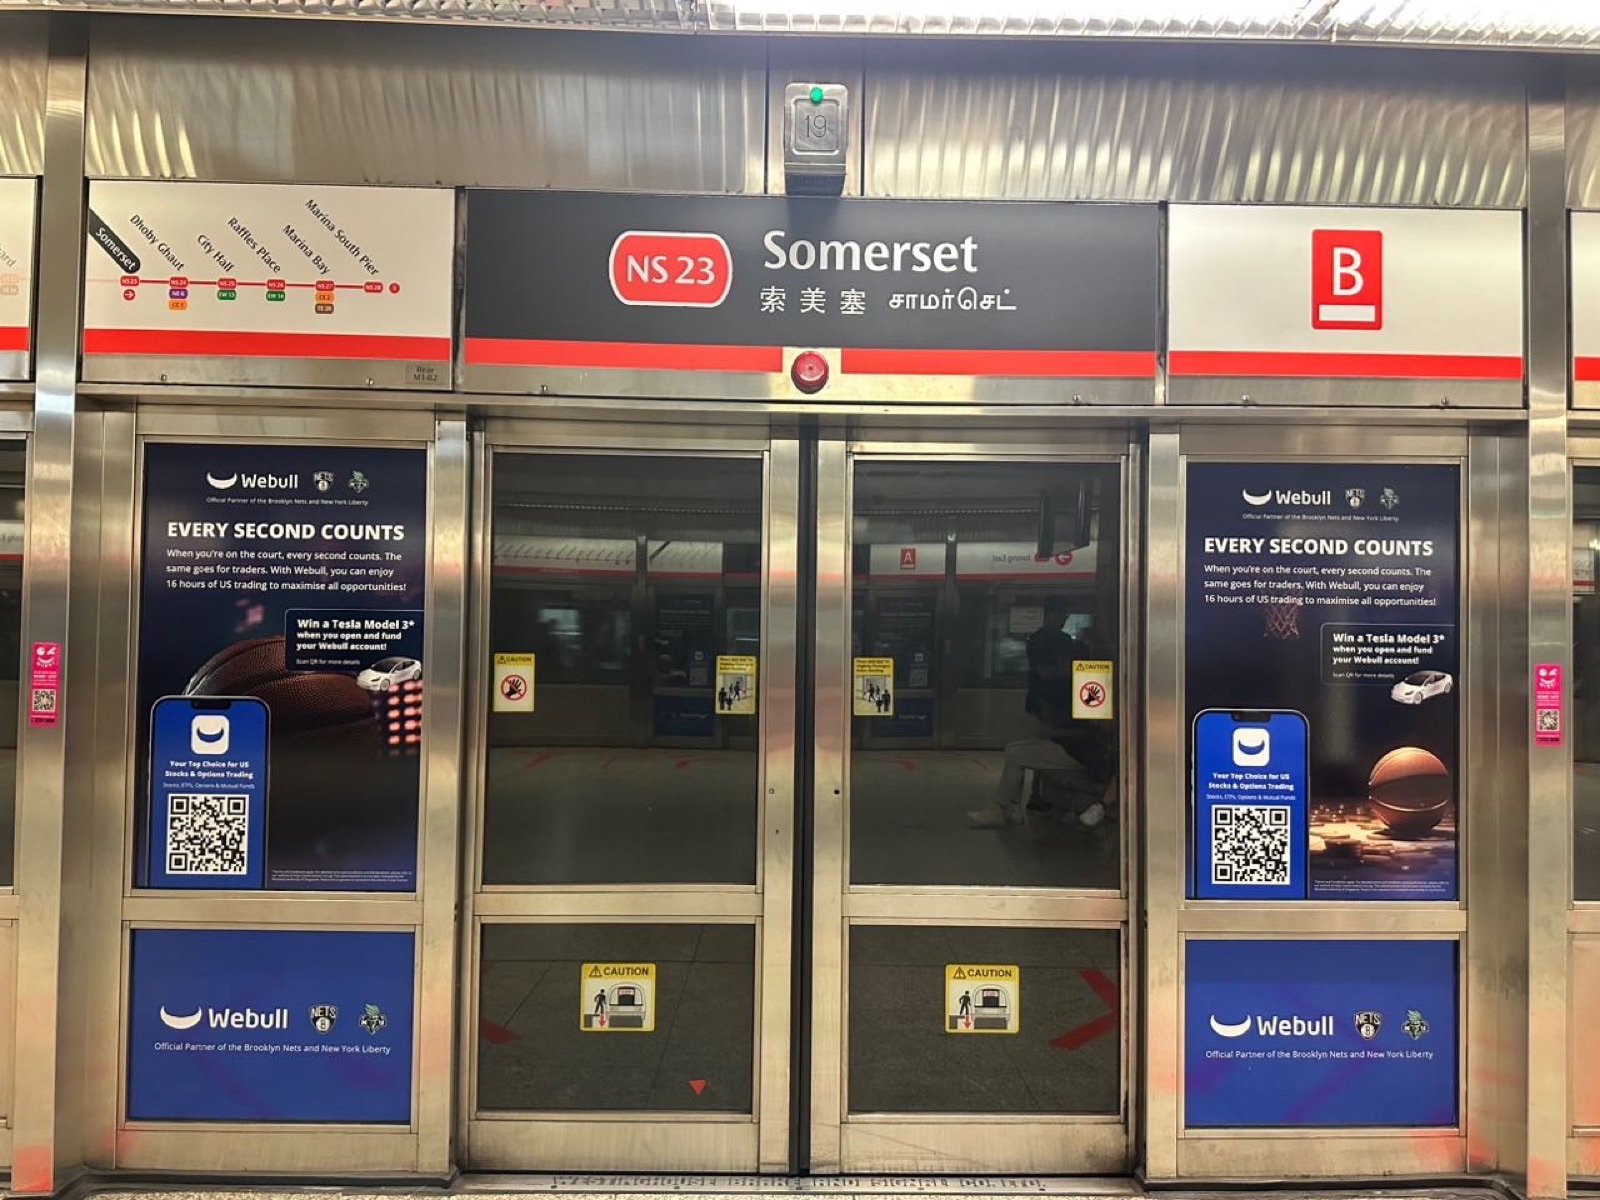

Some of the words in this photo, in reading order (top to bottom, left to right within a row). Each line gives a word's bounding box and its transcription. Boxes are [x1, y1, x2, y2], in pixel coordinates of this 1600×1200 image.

[805, 115, 827, 138] 19
[130, 214, 158, 245] Dhoby
[158, 243, 185, 271] Ghaut
[228, 217, 258, 250] Raffles
[256, 247, 281, 273] Place
[305, 199, 336, 231] Marina
[335, 229, 360, 258] South
[359, 255, 379, 275] Pier
[96, 227, 136, 270] Somerset
[197, 234, 214, 255] City
[213, 252, 235, 272] Hall
[282, 225, 312, 258] Marina
[312, 255, 330, 275] Bay
[763, 230, 978, 273] Somerset
[626, 256, 668, 284] NS
[675, 257, 715, 285] 23
[1332, 246, 1364, 296] B
[760, 286, 866, 315] 索美塞
[241, 473, 298, 489] Webull
[1275, 490, 1331, 505] Webull
[167, 522, 229, 537] EVERY
[234, 522, 315, 539] SECOND
[320, 524, 405, 540] COUNTS
[1204, 537, 1265, 553] EVERY
[1269, 538, 1348, 554] SECOND
[1354, 540, 1433, 556] COUNTS
[166, 550, 194, 558] When
[195, 550, 224, 561] you're
[240, 550, 255, 558] the
[257, 551, 284, 560] court,
[287, 552, 312, 561] every
[314, 551, 346, 560] second
[348, 552, 382, 561] counts.
[385, 552, 402, 561] The
[193, 565, 214, 575] goes
[216, 564, 230, 573] for
[232, 565, 268, 574] traders.
[270, 565, 292, 574] With
[294, 565, 328, 576] Webull,
[330, 567, 348, 577] you
[368, 567, 394, 578] enjoy
[1204, 564, 1230, 573] When
[1233, 565, 1260, 576] you're
[1276, 565, 1291, 574] the
[1293, 566, 1319, 575] court,
[1321, 568, 1346, 576] every
[1348, 567, 1379, 575] second
[1381, 568, 1412, 576] counts.
[1415, 568, 1431, 576] The
[166, 580, 177, 588] 16
[179, 579, 206, 588] hours
[208, 580, 218, 588] of
[234, 580, 267, 591] trading
[281, 581, 326, 590] maximise
[328, 581, 339, 590] all
[340, 582, 406, 592] opportunities!
[1230, 581, 1252, 590] goes
[1254, 580, 1267, 588] for
[1269, 580, 1303, 589] traders.
[1305, 581, 1326, 590] With
[1328, 581, 1362, 591] Webull,
[1363, 583, 1380, 592] you
[1400, 583, 1424, 593] enjoy
[1204, 595, 1215, 603] 16
[1217, 595, 1243, 603] hours
[1245, 595, 1256, 603] of
[1271, 596, 1303, 606] trading
[1317, 596, 1359, 605] maximise
[1361, 596, 1372, 605] all
[1374, 597, 1436, 607] opportunities!
[297, 619, 320, 628] Win
[332, 619, 360, 629] Tesla
[364, 620, 399, 629] Model
[296, 643, 316, 651] your
[1333, 633, 1354, 642] Win
[1366, 634, 1394, 643] Tesla
[1396, 634, 1430, 644] Model
[604, 966, 649, 976] CAUTION
[968, 968, 1012, 978] CAUTION
[208, 1008, 288, 1029] Webull
[310, 1005, 337, 1018] NETS
[1257, 1015, 1334, 1036] Webull
[1355, 1012, 1381, 1024] NETS
[154, 1042, 183, 1050] Official
[185, 1042, 216, 1051] Partner
[217, 1042, 227, 1051] of
[229, 1043, 242, 1051] the
[244, 1043, 280, 1054] Brooklyn
[363, 1045, 390, 1055] Liberty
[1206, 1050, 1234, 1058] Official
[1267, 1050, 1277, 1058] of
[1293, 1050, 1328, 1060] Brooklyn
[1406, 1050, 1433, 1060] Liberty
